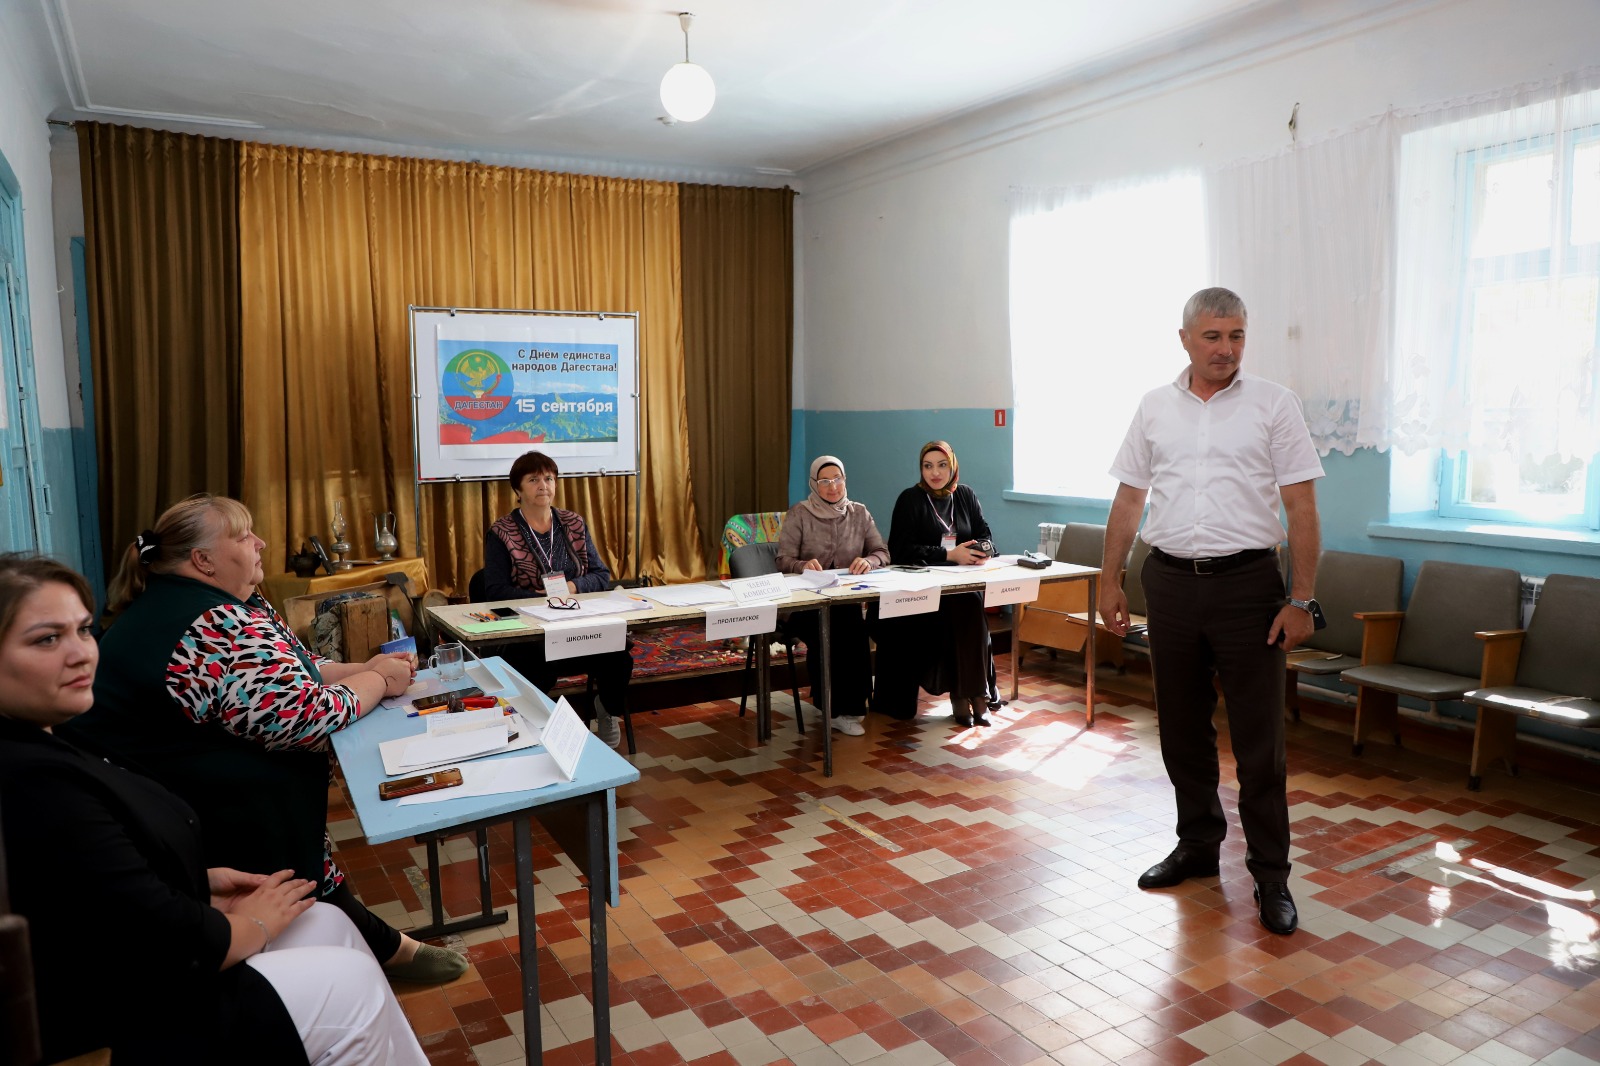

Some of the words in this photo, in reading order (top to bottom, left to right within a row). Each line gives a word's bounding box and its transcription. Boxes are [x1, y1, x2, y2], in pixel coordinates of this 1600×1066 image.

[518, 349, 526, 359] С
[529, 349, 559, 360] Днём
[563, 350, 611, 361] единства
[511, 363, 557, 373] народов
[561, 362, 617, 373] Дагестана!
[454, 400, 503, 410] ДАГЕСТАН
[515, 398, 535, 413] 15
[541, 398, 613, 416] сентября
[746, 579, 771, 589] ЧЛЕНЫ
[742, 586, 781, 598] КОМИССИИ
[895, 595, 928, 604] ОКТЯБРЬСКОЕ
[717, 614, 760, 625] ПРОЛЕТАРСКОЕ
[566, 633, 602, 643] ШКОЛЬНОЕ
